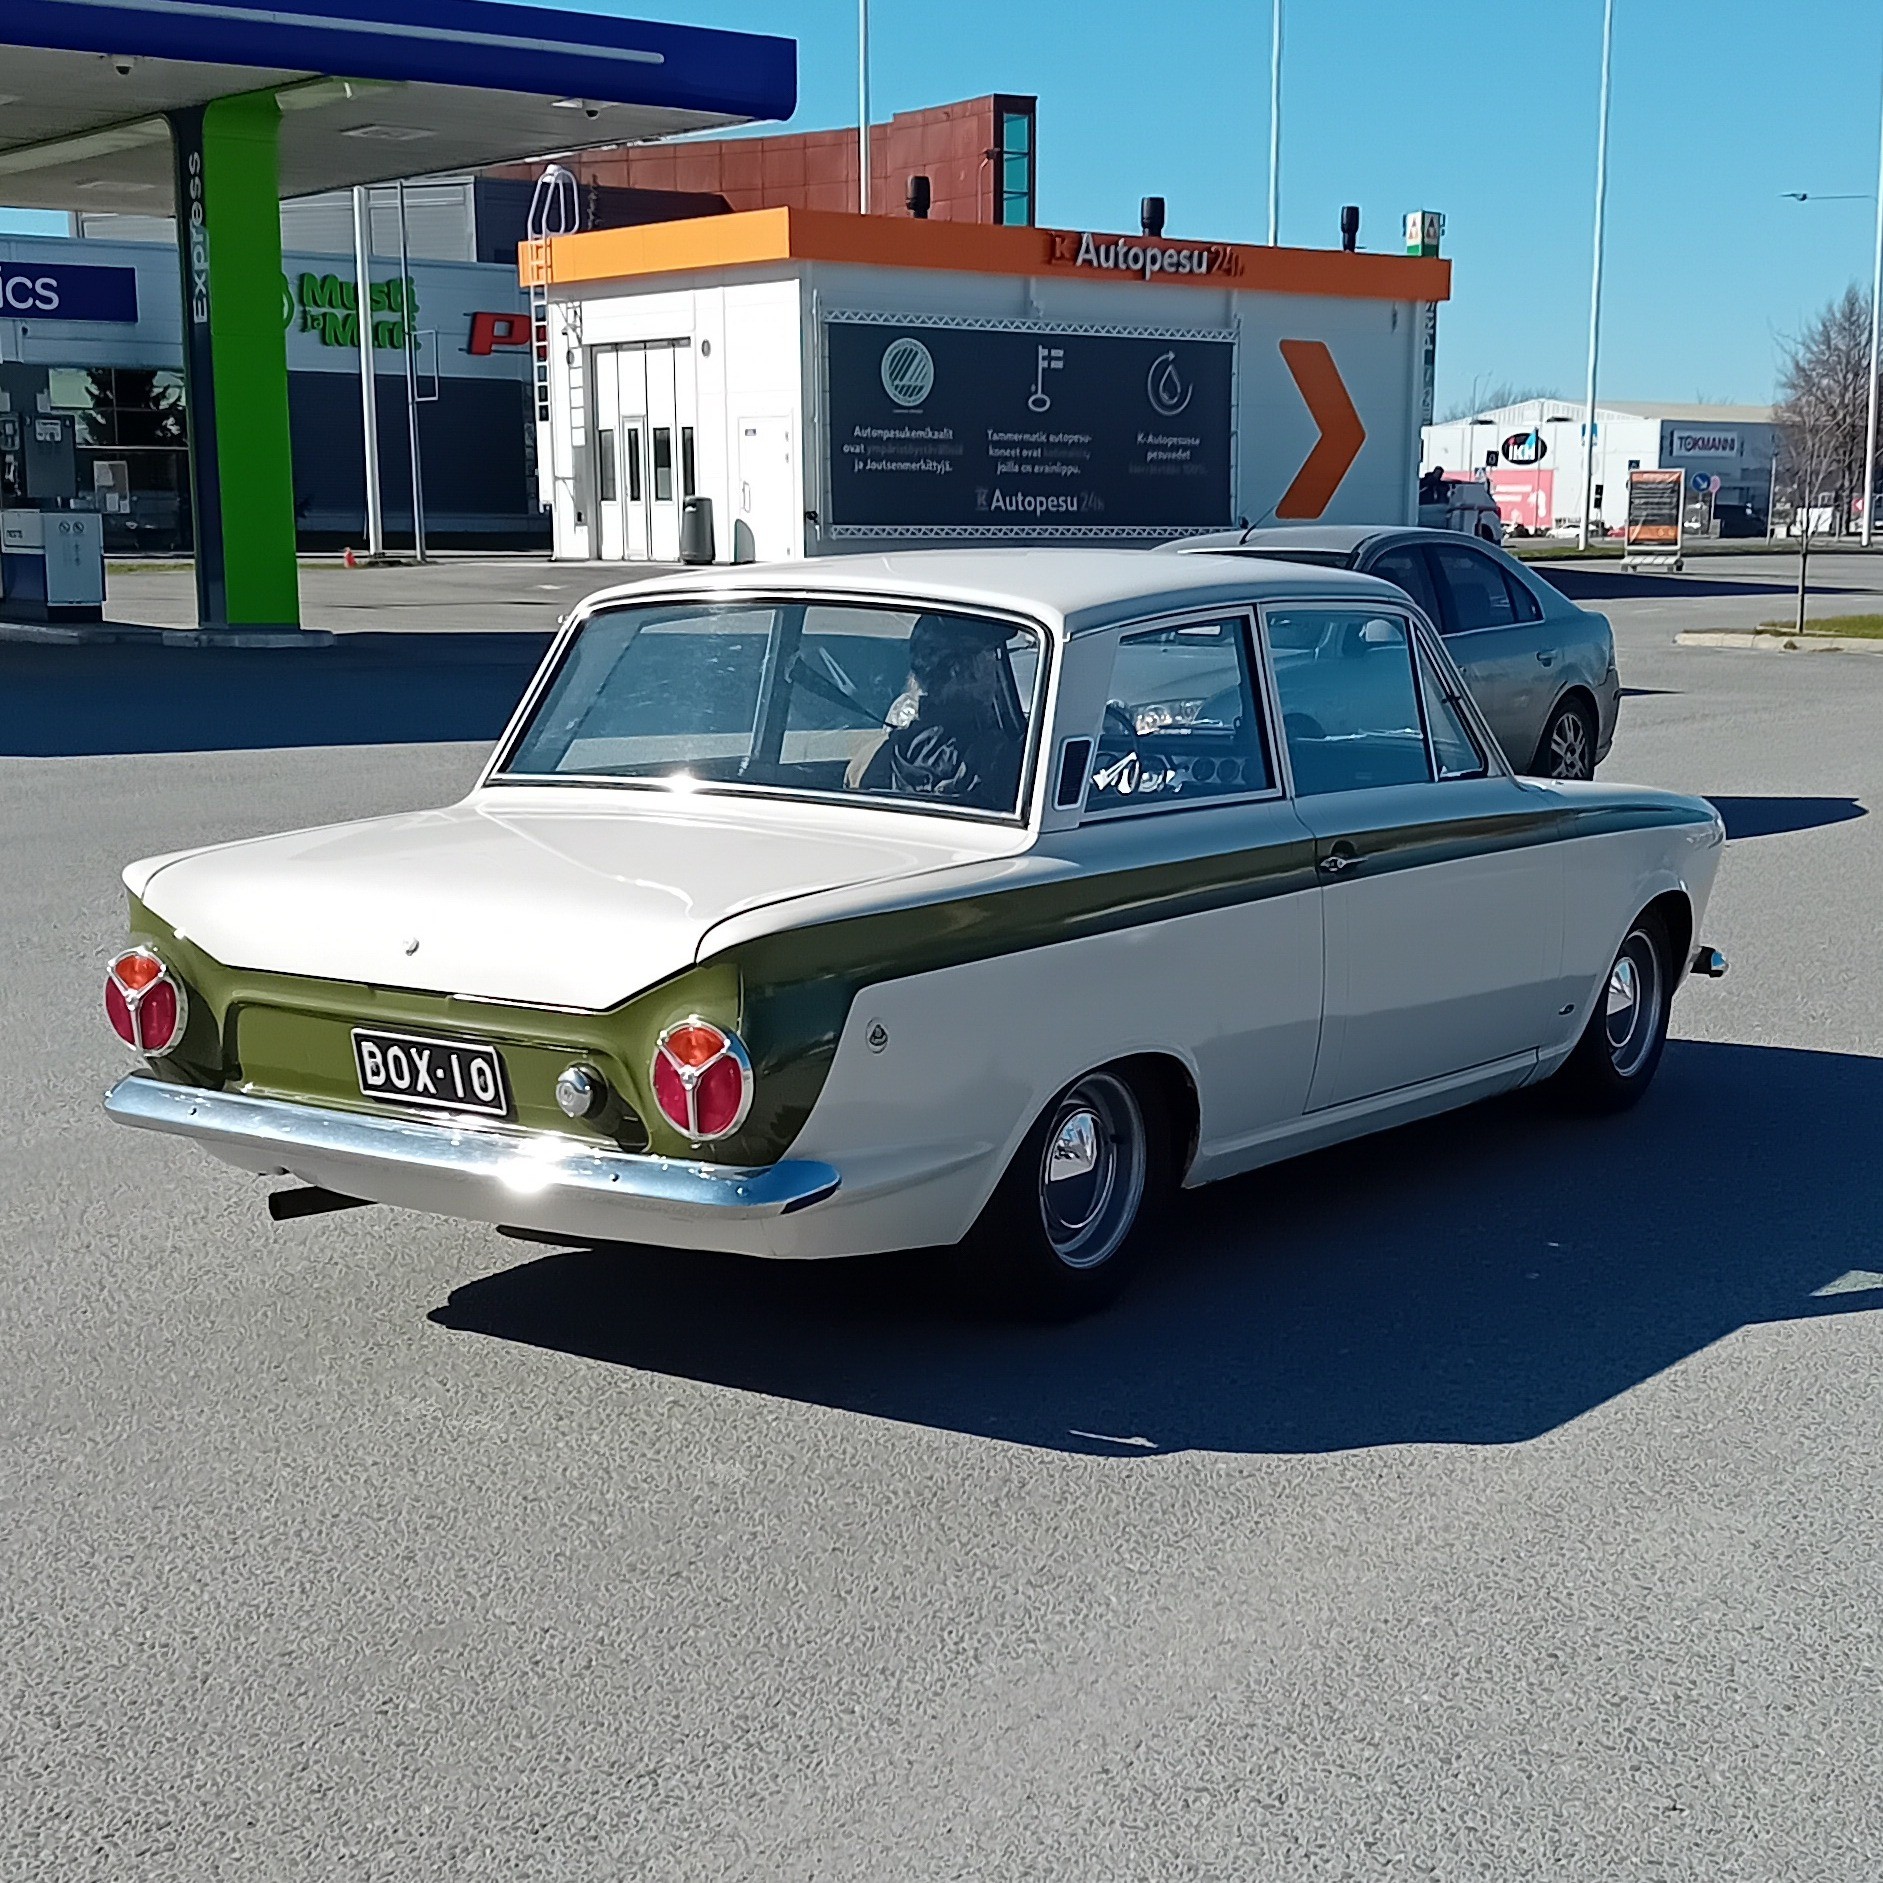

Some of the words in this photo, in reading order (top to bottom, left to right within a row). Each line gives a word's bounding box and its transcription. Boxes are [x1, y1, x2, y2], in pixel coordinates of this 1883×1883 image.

[188, 151, 208, 324] Express
[1076, 232, 1208, 281] Autopesu
[842, 443, 866, 454] ovat
[1677, 434, 1736, 452] TOKMANNI
[990, 488, 1078, 518] Autopesu
